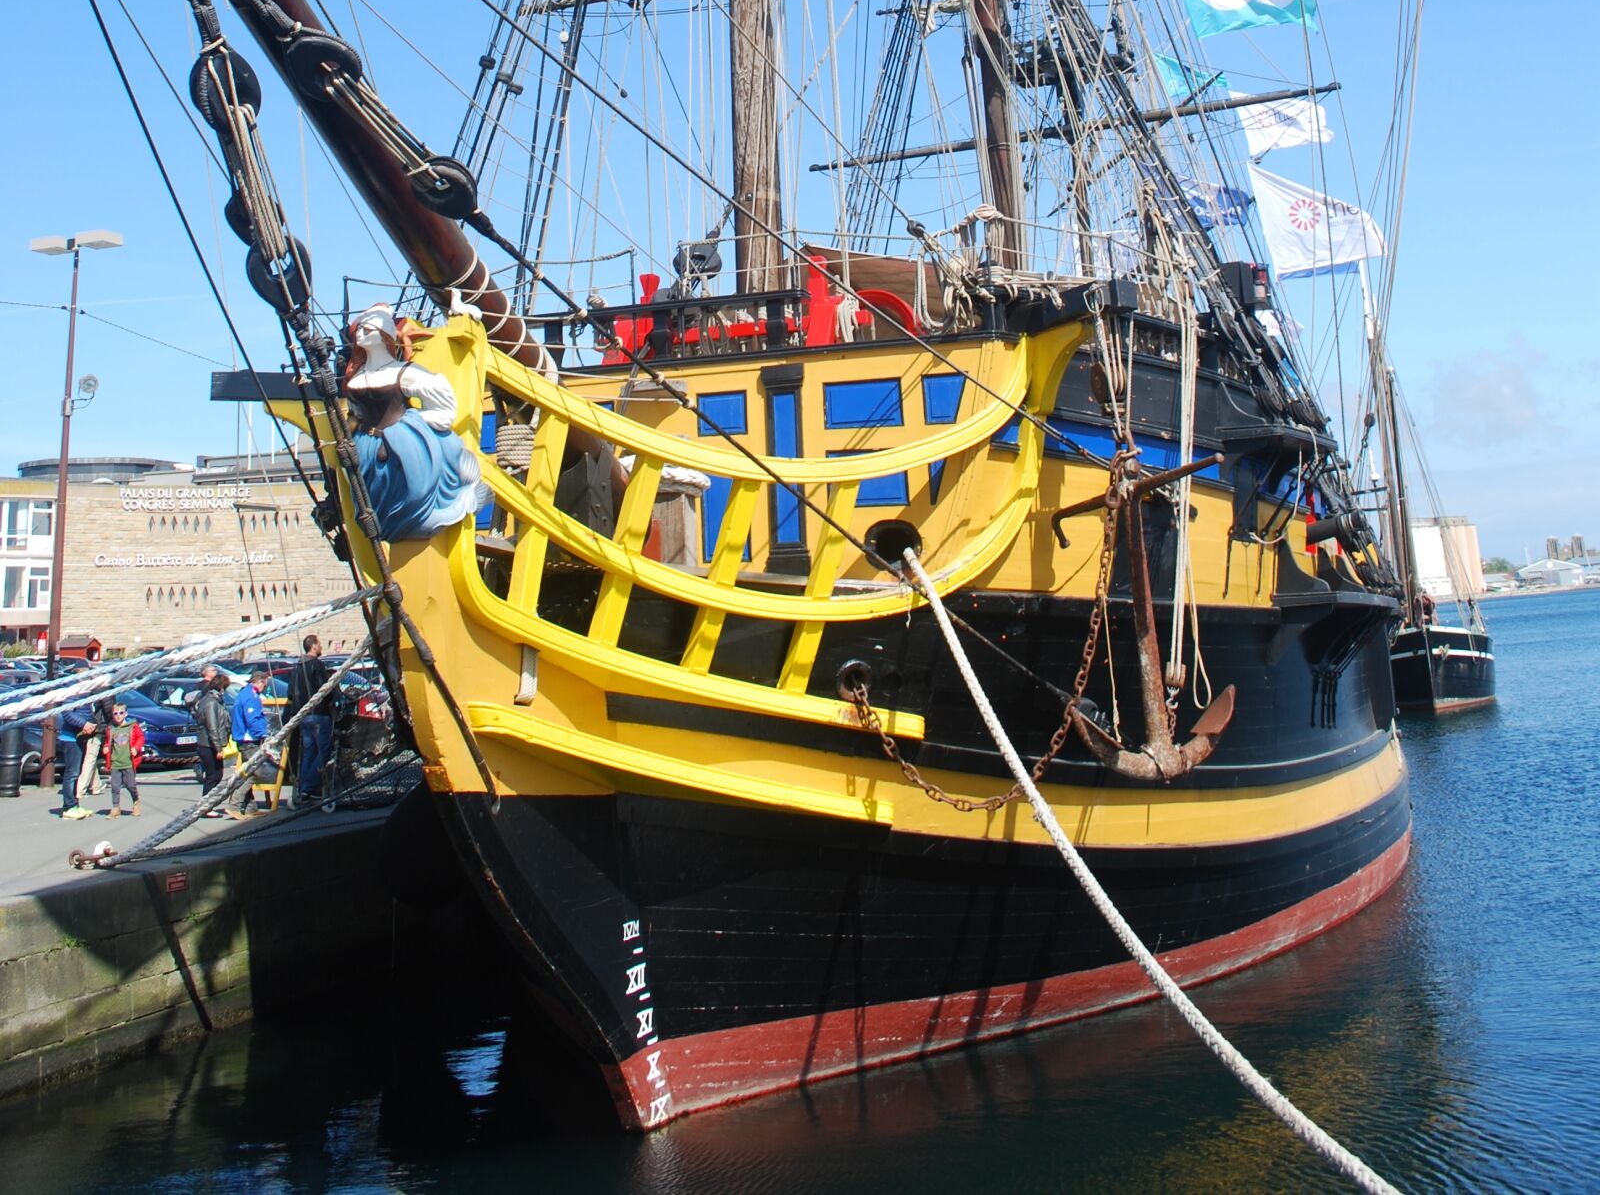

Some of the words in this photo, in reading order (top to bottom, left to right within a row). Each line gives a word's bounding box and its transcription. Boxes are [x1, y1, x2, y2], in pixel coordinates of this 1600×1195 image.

[120, 488, 156, 499] PALAIS
[157, 488, 173, 499] DU
[175, 488, 215, 499] GRAND
[217, 488, 252, 499] LARGE
[179, 499, 248, 510] SEMINAIR
[94, 554, 132, 567] Casino
[135, 553, 182, 567] Barrière
[185, 552, 200, 567] de
[626, 962, 647, 995] XII
[636, 1007, 654, 1039] XI
[646, 1050, 661, 1082] X
[649, 1092, 671, 1127] IX
